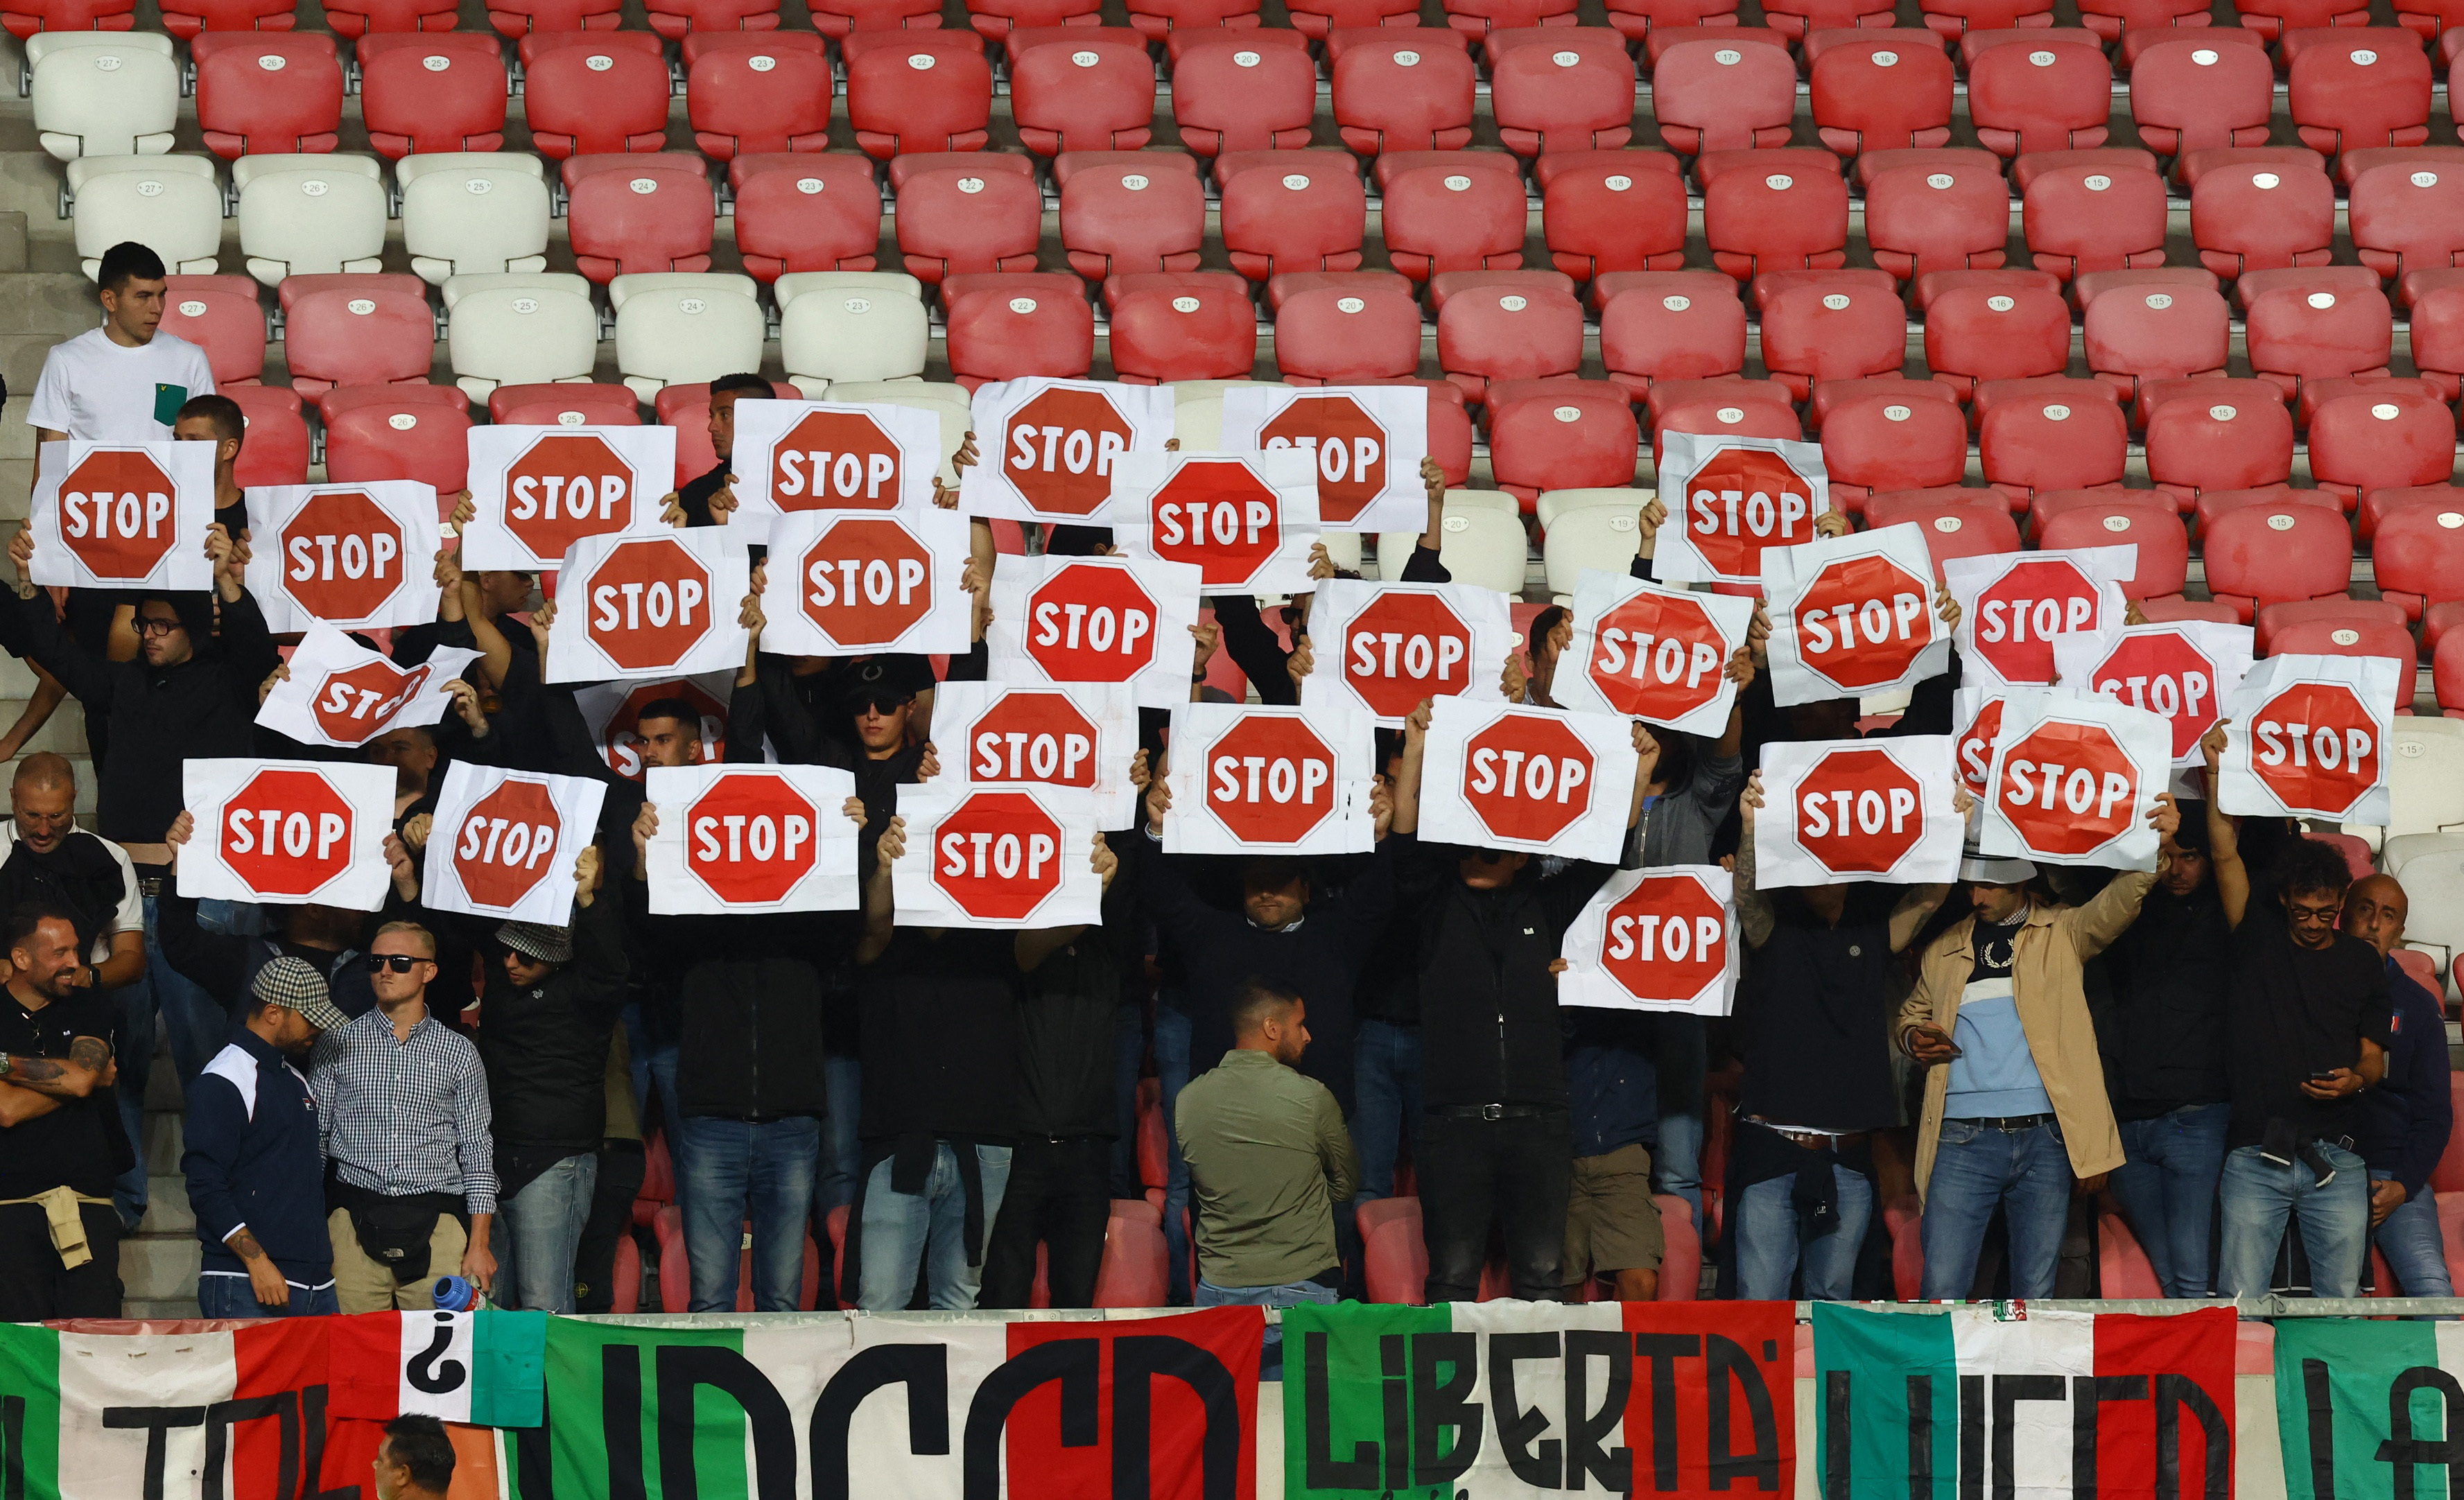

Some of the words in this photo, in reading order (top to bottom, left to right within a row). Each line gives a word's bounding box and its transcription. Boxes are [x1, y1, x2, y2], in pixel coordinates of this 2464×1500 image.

[1079, 55, 1090, 64] 21
[1241, 55, 1253, 64] 20
[1402, 54, 1412, 63] 19
[1561, 55, 1572, 63] 18
[1723, 53, 1733, 62] 17
[1880, 55, 1891, 63] 16
[2038, 54, 2048, 63] 15
[2359, 53, 2369, 62] 13
[103, 59, 114, 68] 27
[266, 58, 277, 67] 26
[431, 59, 442, 68] 25
[593, 59, 605, 68] 24
[756, 59, 768, 68] 23
[916, 58, 928, 67] 22
[1129, 178, 1140, 187] 21
[1290, 178, 1302, 187] 20
[1452, 179, 1464, 188] 19
[1614, 179, 1624, 188] 18
[1775, 178, 1785, 186] 17
[1936, 177, 1946, 186] 16
[2092, 178, 2103, 187] 15
[2419, 175, 2430, 184] 13
[144, 184, 156, 193] 27
[309, 184, 321, 193] 26
[474, 182, 485, 191] 25
[638, 182, 649, 191] 24
[804, 182, 816, 191] 23
[964, 181, 976, 190] 22
[1017, 302, 1028, 310] 22
[1181, 300, 1191, 309] 21
[1345, 301, 1357, 310] 20
[1509, 299, 1519, 308] 19
[1672, 299, 1683, 308] 18
[1831, 297, 1842, 306] 17
[1996, 299, 2007, 308] 16
[2154, 297, 2165, 306] 15
[187, 304, 198, 313] 27
[356, 303, 367, 311] 26
[519, 302, 531, 311] 25
[687, 302, 698, 311] 24
[852, 302, 863, 311] 23
[1562, 410, 1573, 419] 19
[1725, 411, 1736, 420] 18
[1893, 409, 1902, 418] 17
[2051, 408, 2063, 417] 16
[2218, 408, 2229, 418] 15
[397, 417, 408, 426] 26
[566, 415, 578, 424] 25
[1011, 424, 1124, 474] STOP
[1266, 436, 1380, 482] OP
[779, 449, 894, 498] STOP
[512, 476, 626, 520] STOP
[64, 491, 169, 538] STOP
[1692, 489, 1806, 538] STOP
[1159, 501, 1271, 545] STOP
[1450, 520, 1461, 529] 20
[1617, 519, 1629, 528] 19
[1943, 520, 1953, 529] 17
[2112, 519, 2123, 528] 16
[2276, 518, 2287, 527] 15
[289, 532, 397, 582] STOP
[809, 559, 925, 607] STOP
[593, 579, 703, 631] STOP
[1803, 593, 1921, 653] STOP
[1981, 596, 2092, 643] STOP
[1036, 602, 1149, 654] STOP
[2340, 633, 2351, 642] 15
[1351, 631, 1464, 680] STOP
[1597, 628, 1718, 688] STOP
[613, 715, 723, 777] SP
[2257, 721, 2372, 774] STOP
[2406, 745, 2418, 754] 15
[976, 732, 1090, 778] STOP
[1471, 747, 1586, 803] STOP
[1213, 756, 1328, 804] STOP
[2006, 760, 2131, 818] STOP
[1803, 788, 1915, 837] STOP
[229, 808, 345, 860] STOP
[695, 815, 809, 862] STOP
[460, 815, 555, 869] STOP
[942, 833, 1054, 879] STOP
[1608, 915, 1721, 962] STOP
